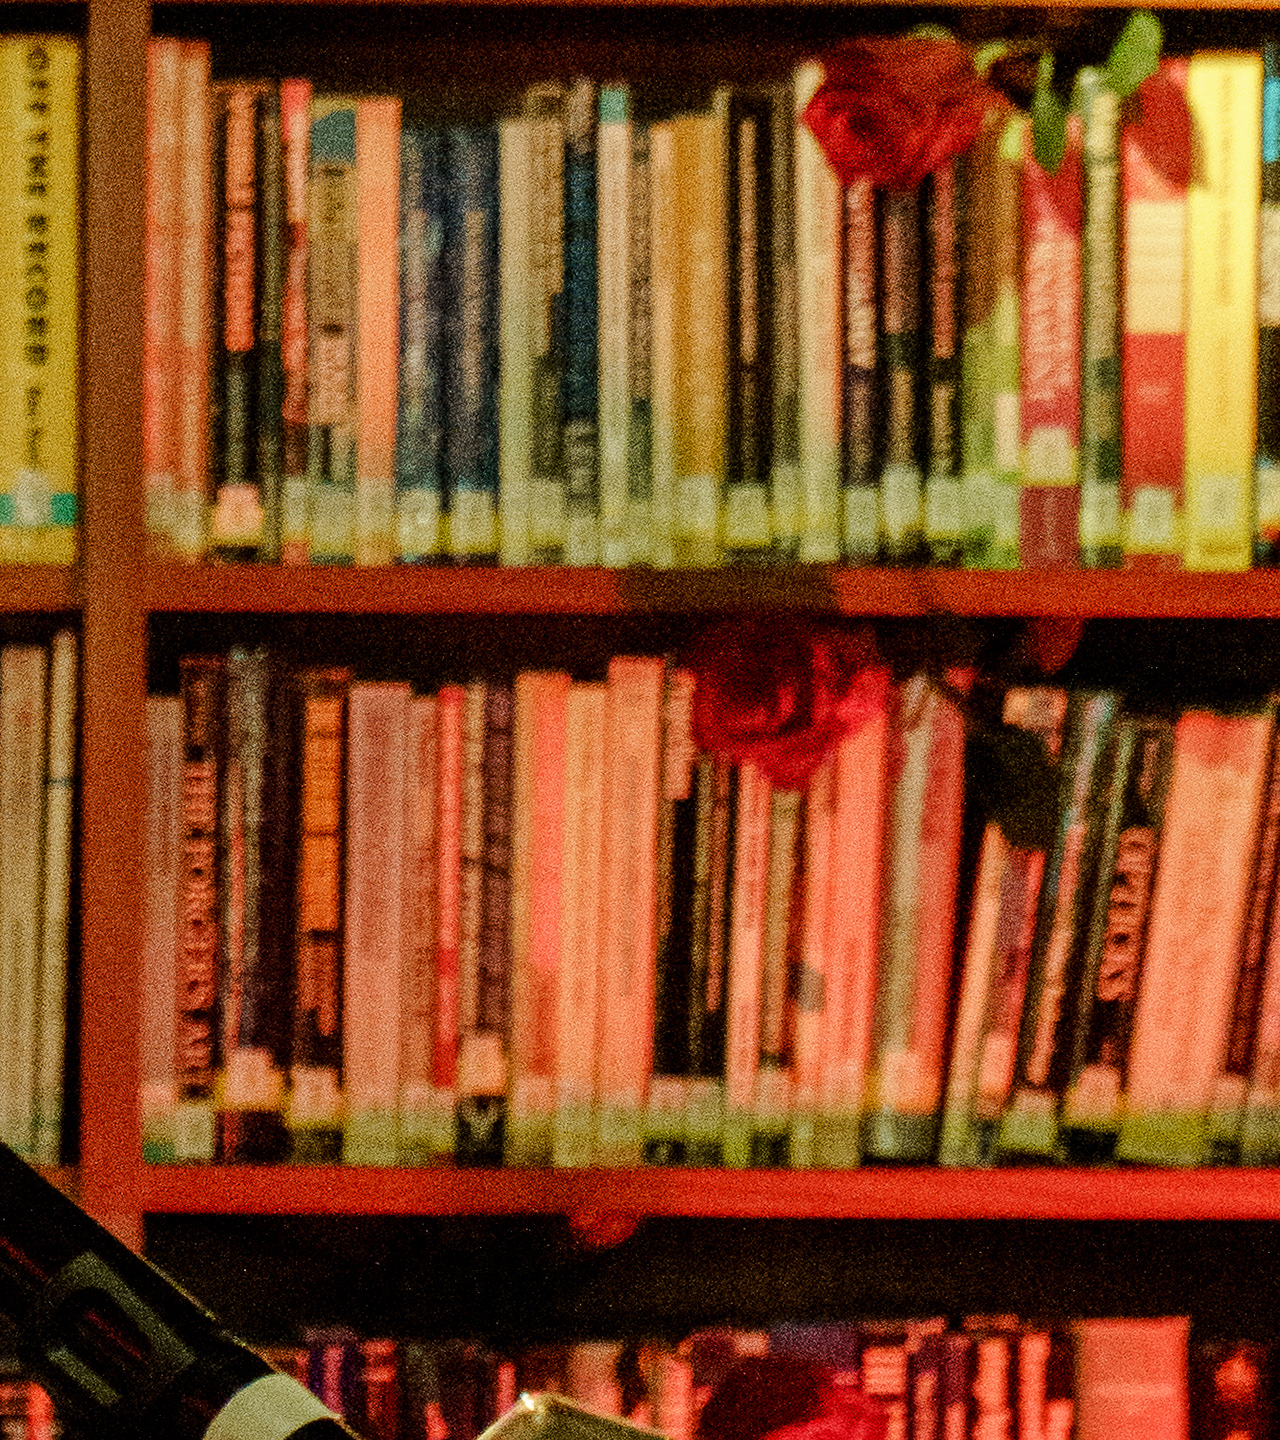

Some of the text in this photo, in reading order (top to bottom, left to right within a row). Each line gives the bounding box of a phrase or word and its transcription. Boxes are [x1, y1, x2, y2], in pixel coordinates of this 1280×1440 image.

[23, 47, 51, 367] OFF THE RECORD
